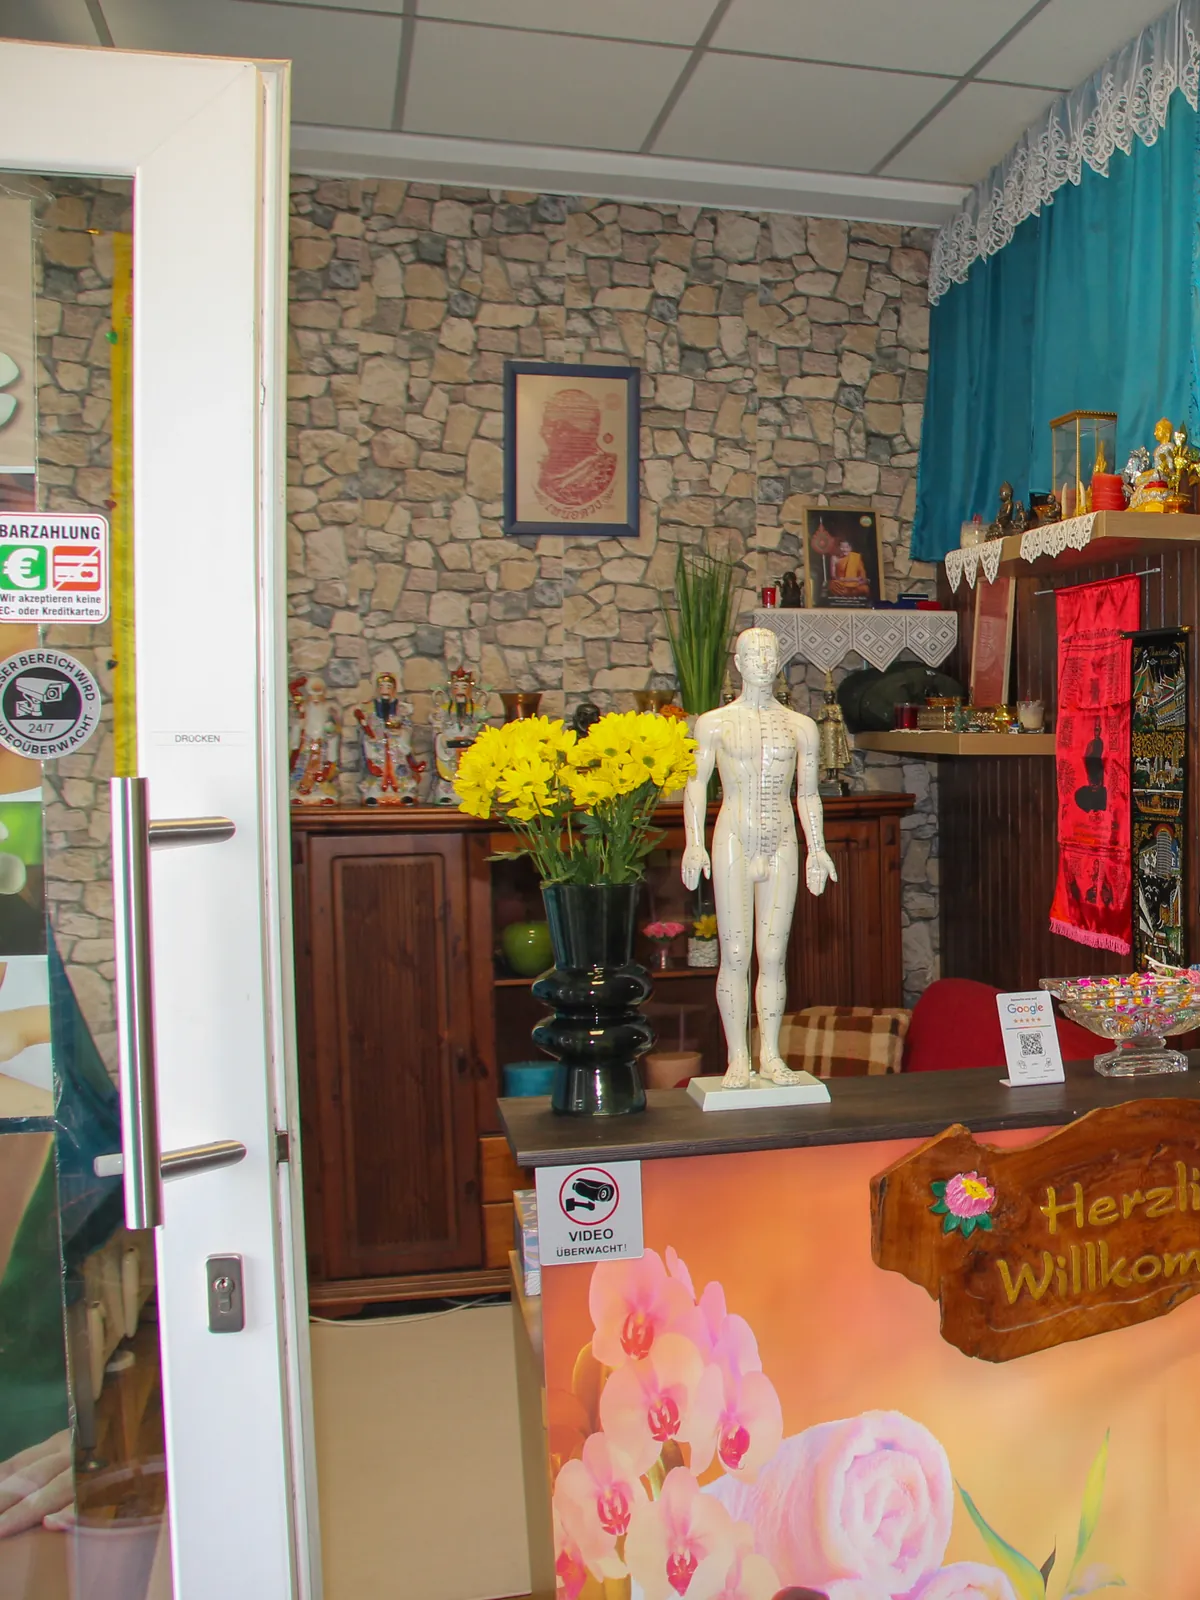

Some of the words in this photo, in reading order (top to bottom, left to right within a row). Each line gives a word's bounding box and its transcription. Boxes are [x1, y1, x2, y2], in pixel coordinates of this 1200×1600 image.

[0, 524, 100, 540] BARZAHLUNG
[0, 594, 16, 603] Wir
[18, 594, 74, 606] akzeptieren
[76, 595, 102, 604] keine
[18, 607, 40, 616] oder
[42, 607, 103, 616] Kreditkarten.
[0, 661, 19, 689] SER
[18, 653, 76, 673] BEREICH
[74, 669, 96, 701] WIRD
[28, 723, 55, 734] 24/7
[1007, 1002, 1044, 1015] Google
[568, 1228, 614, 1242] VIDEO
[556, 1243, 628, 1258] ÜBERWACHT!
